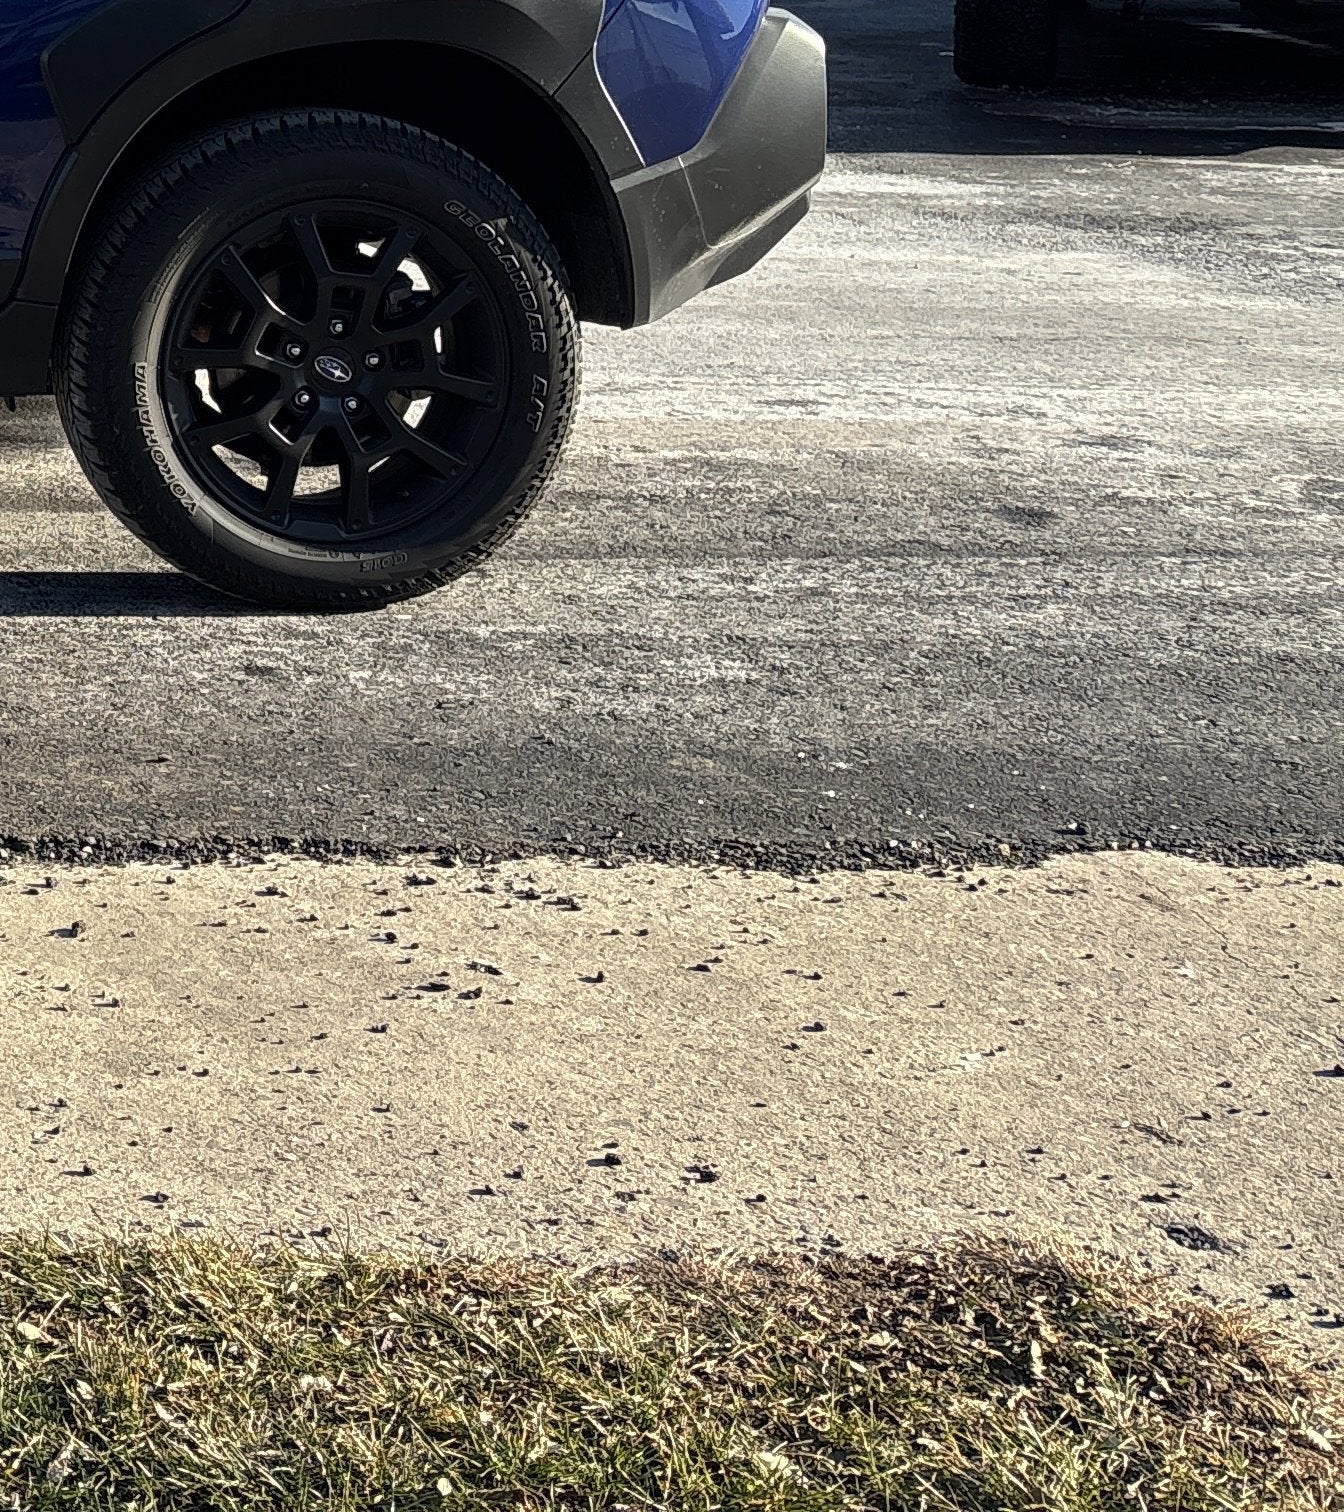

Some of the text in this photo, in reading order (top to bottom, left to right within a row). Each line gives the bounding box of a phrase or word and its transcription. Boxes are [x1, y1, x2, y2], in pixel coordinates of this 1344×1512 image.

[443, 198, 550, 434] GEOLANDAR A/T
[132, 360, 200, 516] YOKOHAMA
